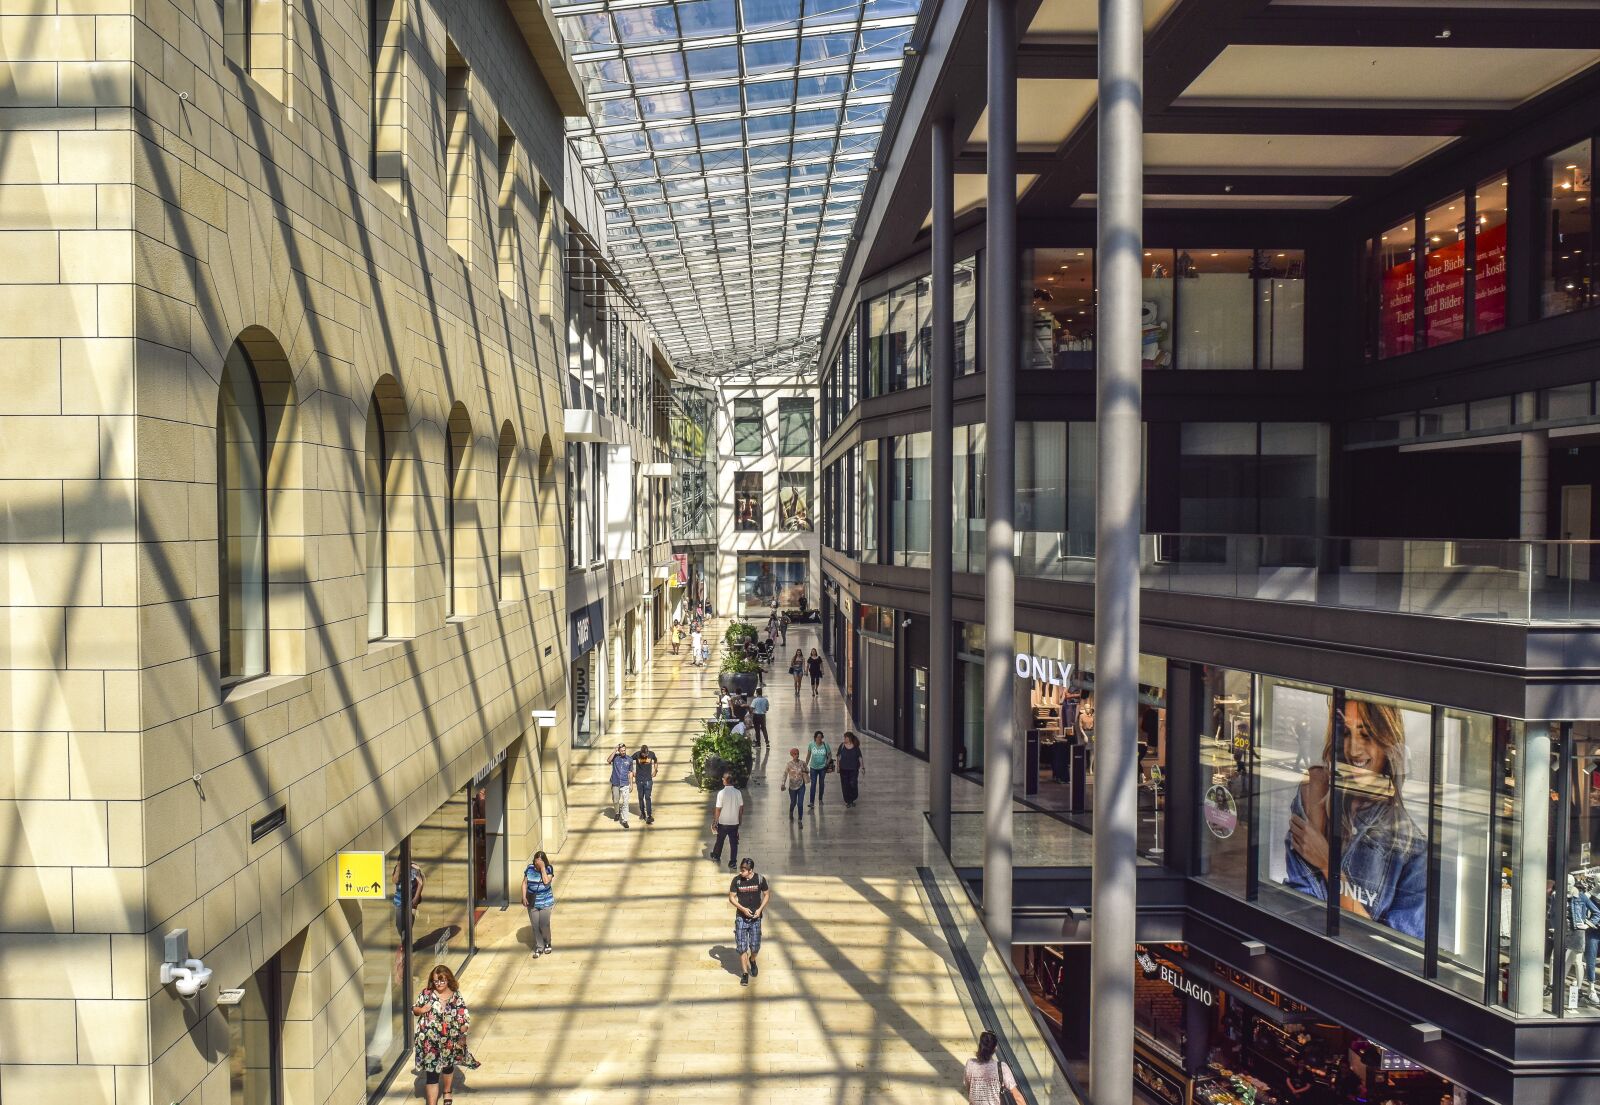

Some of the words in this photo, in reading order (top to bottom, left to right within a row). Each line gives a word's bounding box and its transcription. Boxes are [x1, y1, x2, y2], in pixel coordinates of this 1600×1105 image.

[1425, 265, 1442, 279] ohne
[1440, 294, 1462, 310] Bilder
[1015, 653, 1072, 688] ONLY
[1161, 965, 1213, 1007] BELLAGIO
